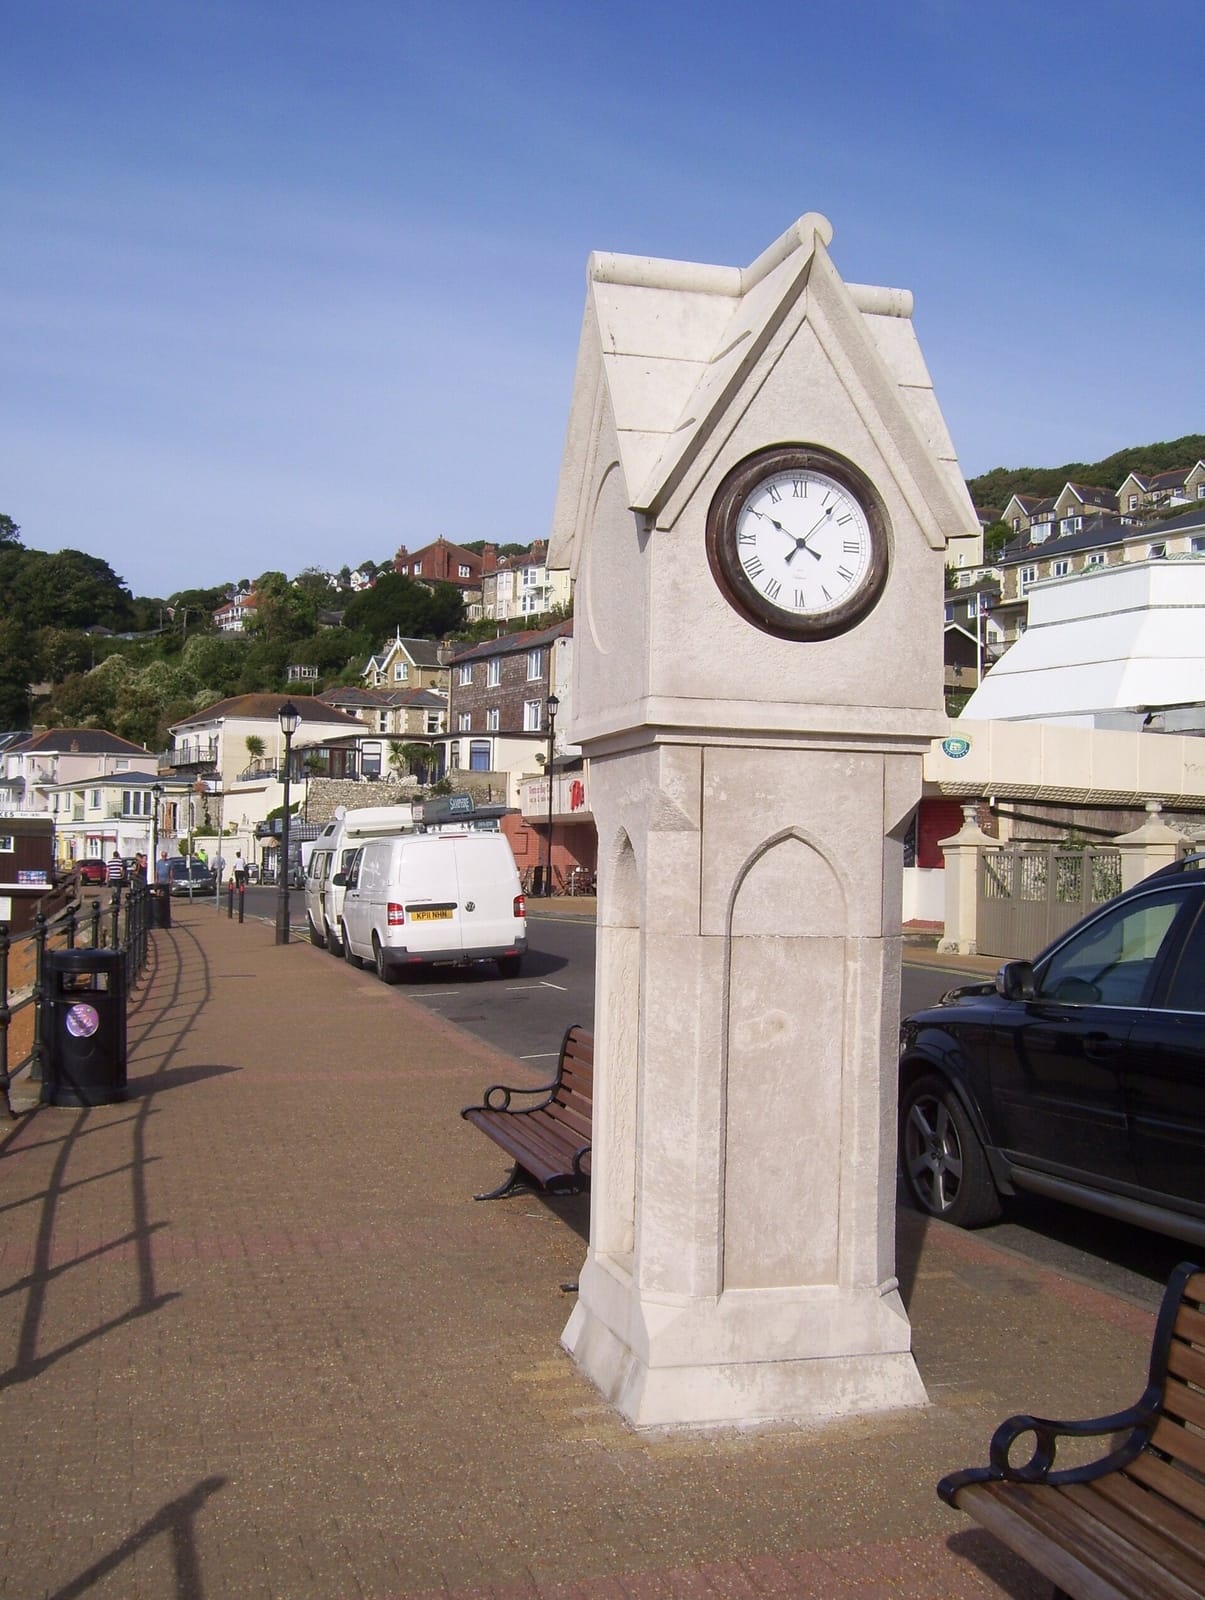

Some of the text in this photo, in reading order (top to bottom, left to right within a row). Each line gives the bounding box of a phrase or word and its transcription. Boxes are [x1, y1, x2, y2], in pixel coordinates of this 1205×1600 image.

[765, 485, 782, 504] XI
[792, 480, 808, 498] XII
[821, 491, 831, 506] I
[837, 513, 853, 527] II
[739, 533, 757, 545] IX
[843, 541, 860, 554] III
[743, 556, 764, 580] VIII
[837, 565, 854, 582] IV
[764, 578, 782, 600] VII
[821, 585, 832, 601] V
[794, 589, 805, 607] VI
